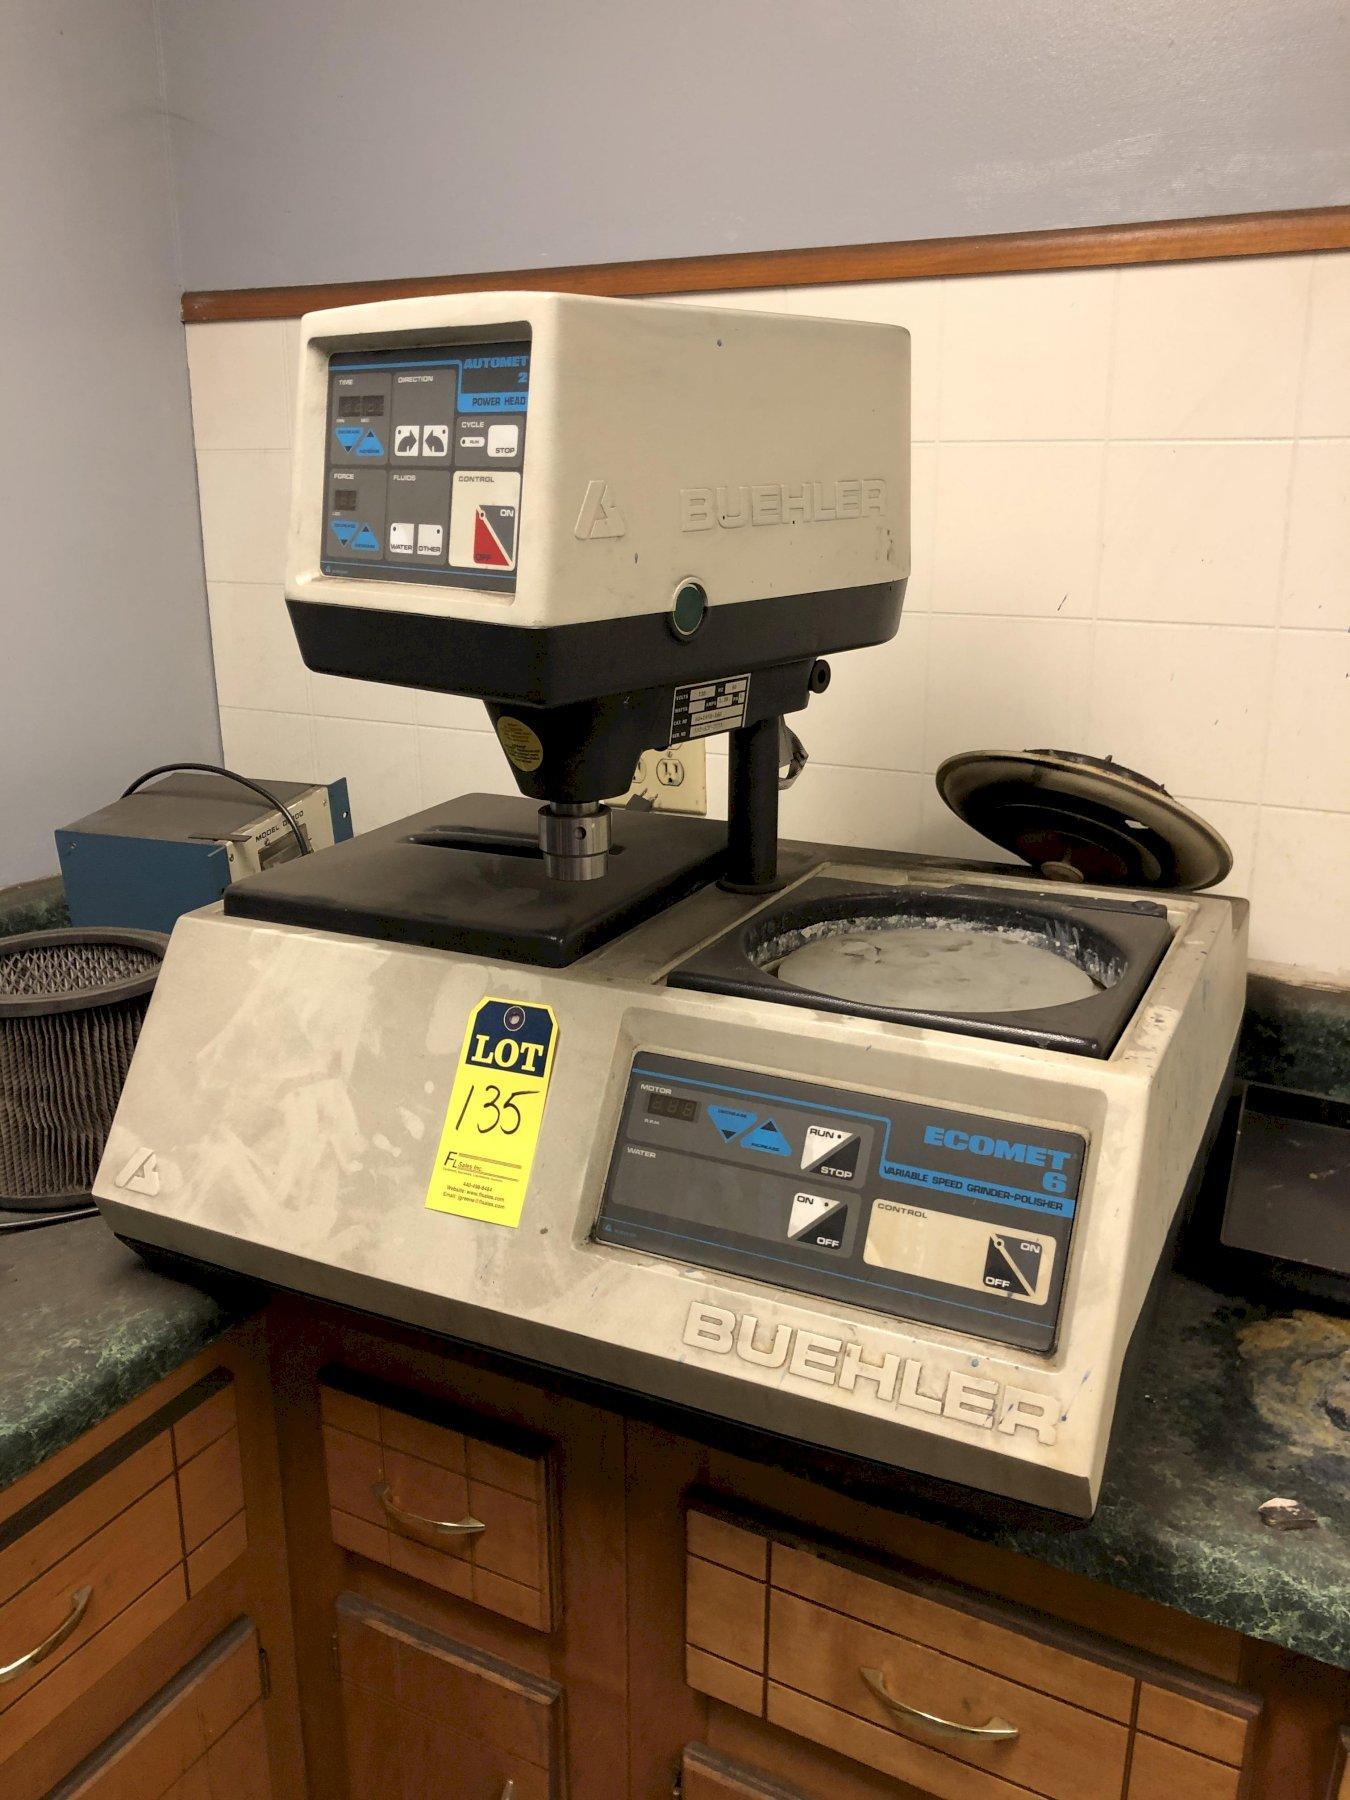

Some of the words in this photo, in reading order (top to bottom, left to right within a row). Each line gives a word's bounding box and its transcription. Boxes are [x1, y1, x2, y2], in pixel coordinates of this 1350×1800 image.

[464, 355, 528, 370] AUTOMET
[398, 375, 433, 383] DIRECTION
[518, 372, 528, 383] 2
[472, 398, 500, 407] POWER
[504, 396, 526, 406] HEAD
[461, 421, 485, 429] CYCLE
[393, 474, 416, 482] FLUIDS
[458, 475, 495, 483] CONTROL
[680, 478, 888, 532] BUEHLER
[500, 509, 514, 518] ON
[391, 543, 413, 551] WATER
[418, 545, 441, 553] OTHER
[255, 826, 280, 843] MODEL
[471, 1034, 544, 1072] LOT
[640, 1083, 672, 1095] MOTOR
[455, 1084, 540, 1135] 135
[809, 1128, 834, 1139] RUN
[627, 1146, 656, 1159] WATER
[924, 1125, 1072, 1171] ECOMET
[820, 1166, 853, 1179] STOP
[883, 1165, 928, 1183] VARIABLE
[932, 1175, 963, 1190] SPEED
[967, 1183, 1063, 1212] GRINDER-POLISHER
[1042, 1171, 1068, 1194] 6
[796, 1195, 814, 1205] ON
[877, 1203, 928, 1219] CONTROL
[816, 1237, 840, 1248] OFF
[1020, 1242, 1041, 1254] ON
[985, 1276, 1010, 1289] OFF
[682, 1300, 1064, 1446] BUEHLER
